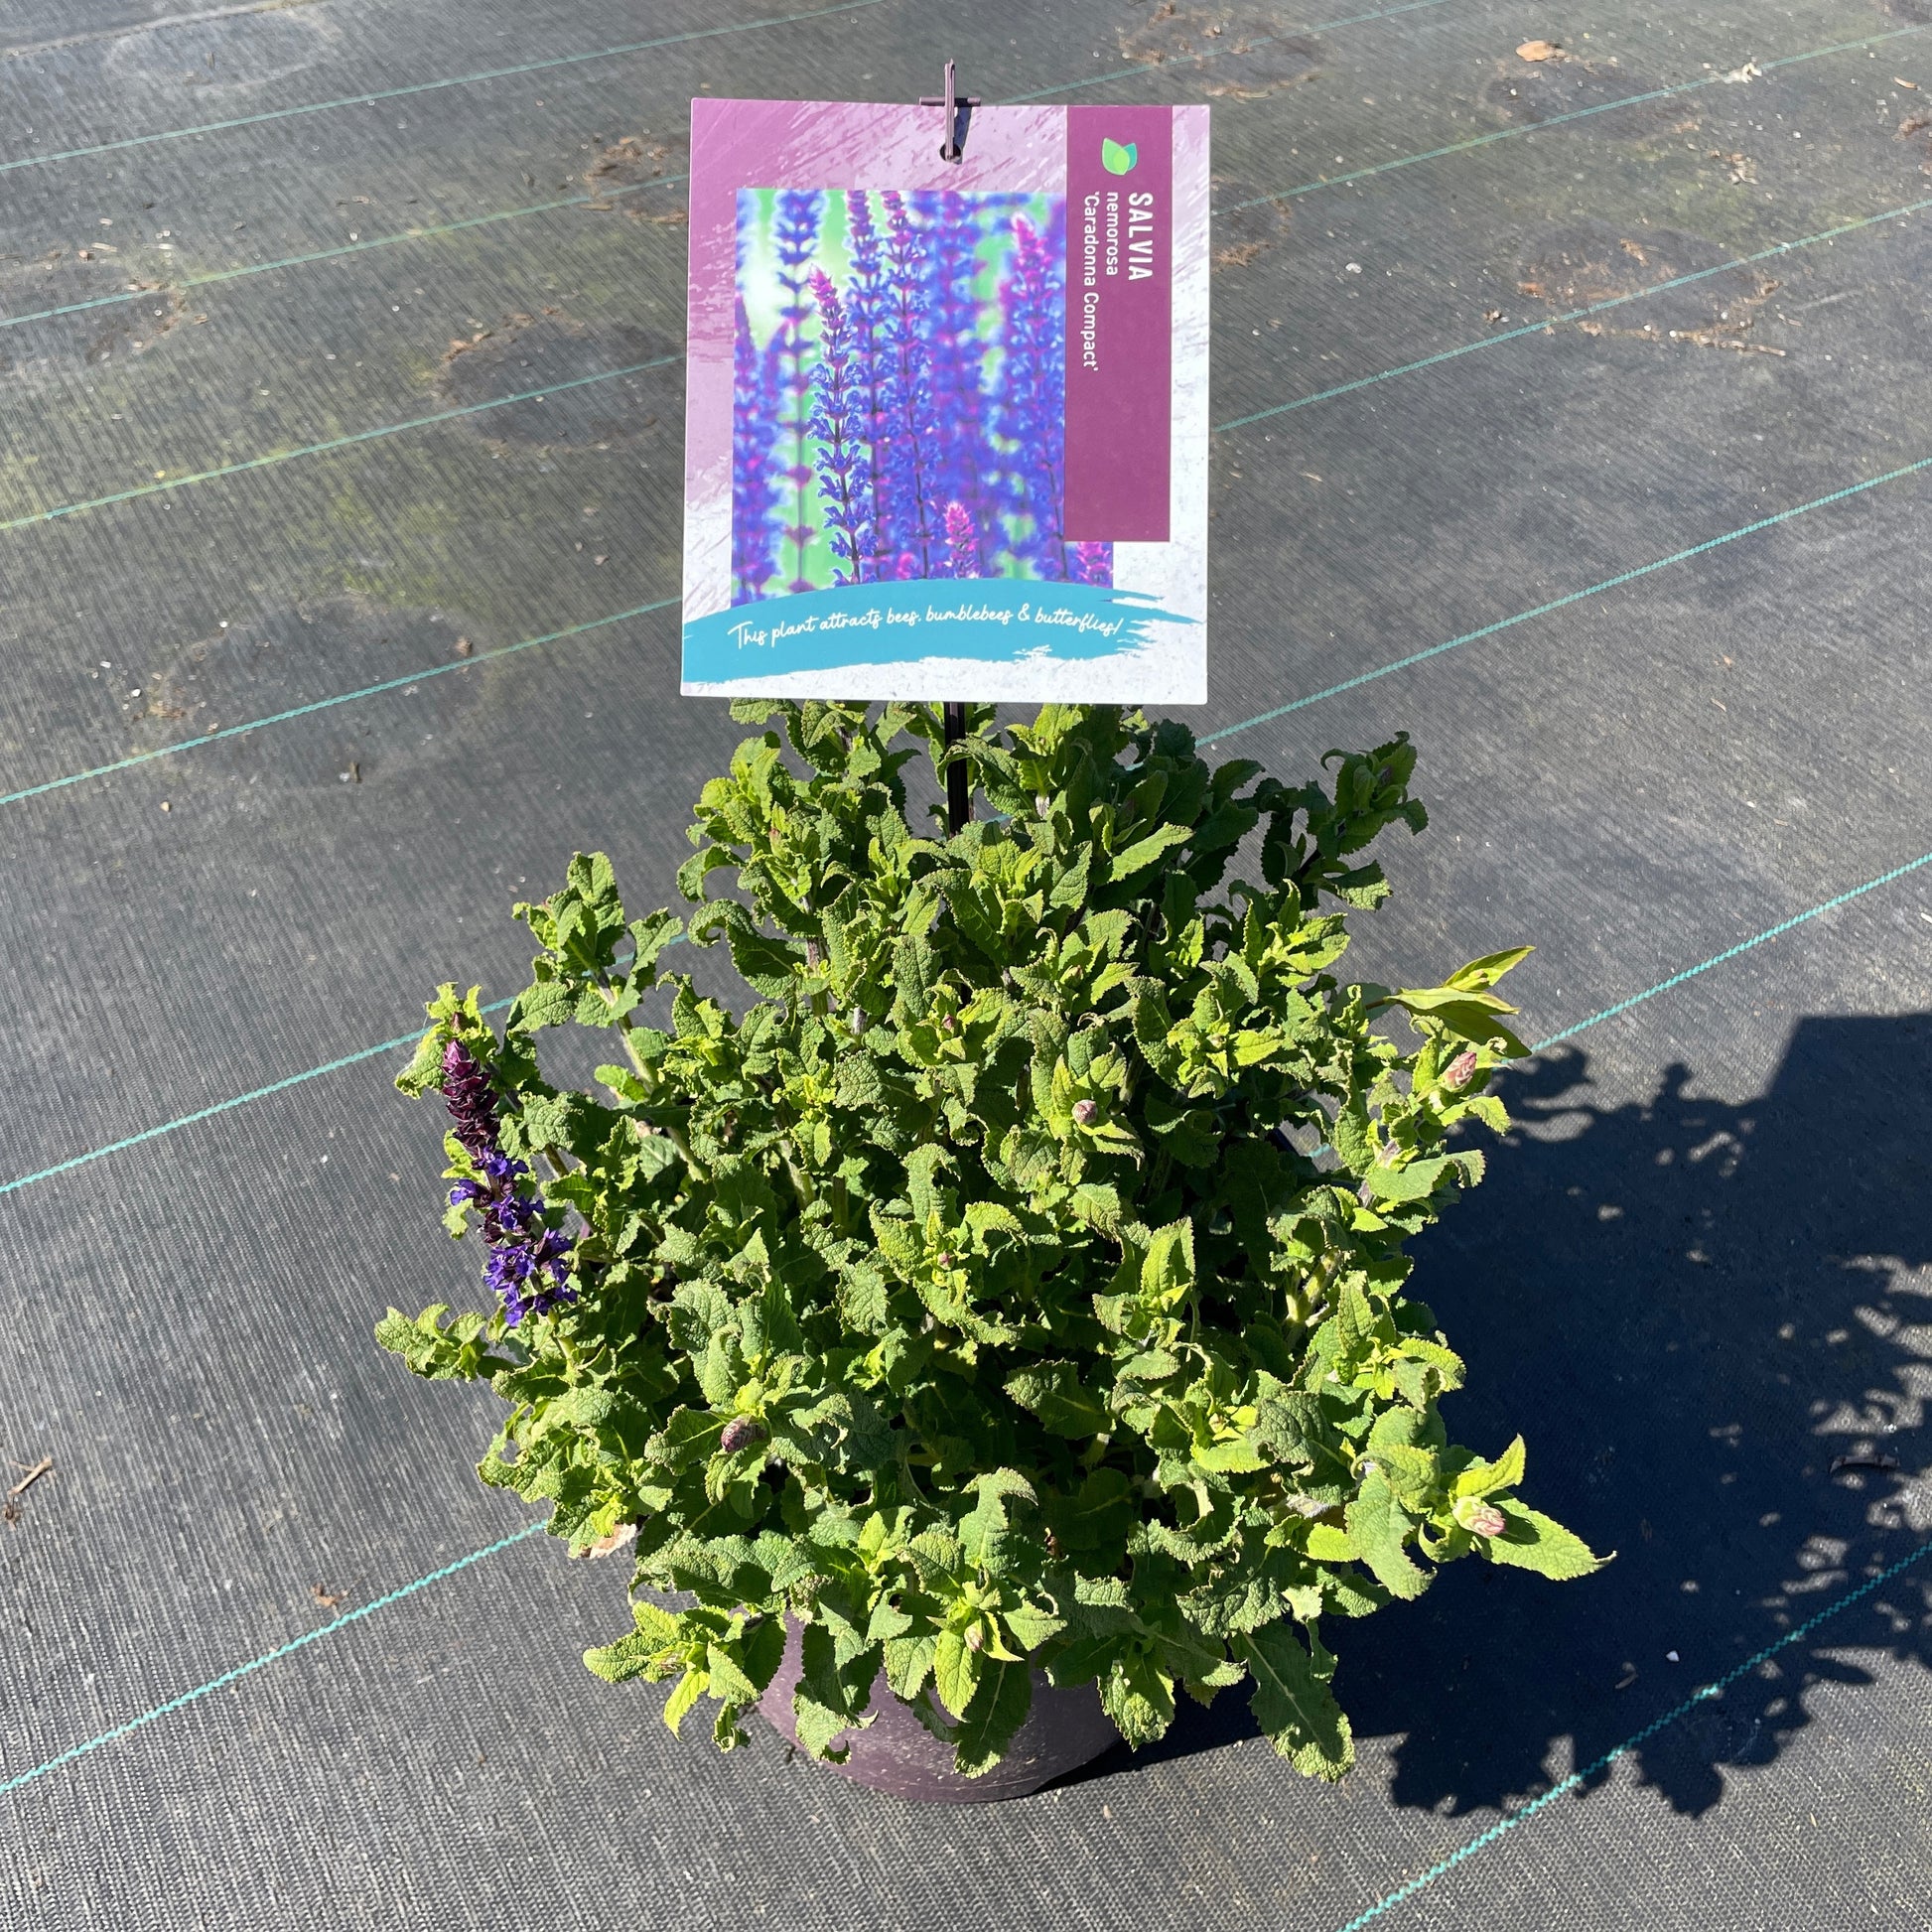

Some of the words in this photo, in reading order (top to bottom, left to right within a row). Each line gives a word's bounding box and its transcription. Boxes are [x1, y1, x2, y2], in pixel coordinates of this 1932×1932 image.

[1084, 191, 1099, 286] 'Caradonna
[1106, 192, 1119, 276] nemorosa
[1128, 193, 1153, 280] SALVIA
[1080, 292, 1099, 371] Compact'
[728, 621, 767, 649] This
[770, 617, 817, 647] plant
[819, 609, 883, 630] attracts
[926, 604, 1014, 624] bumblebees
[1018, 603, 1032, 621] &
[1035, 607, 1124, 636] butterflies!
